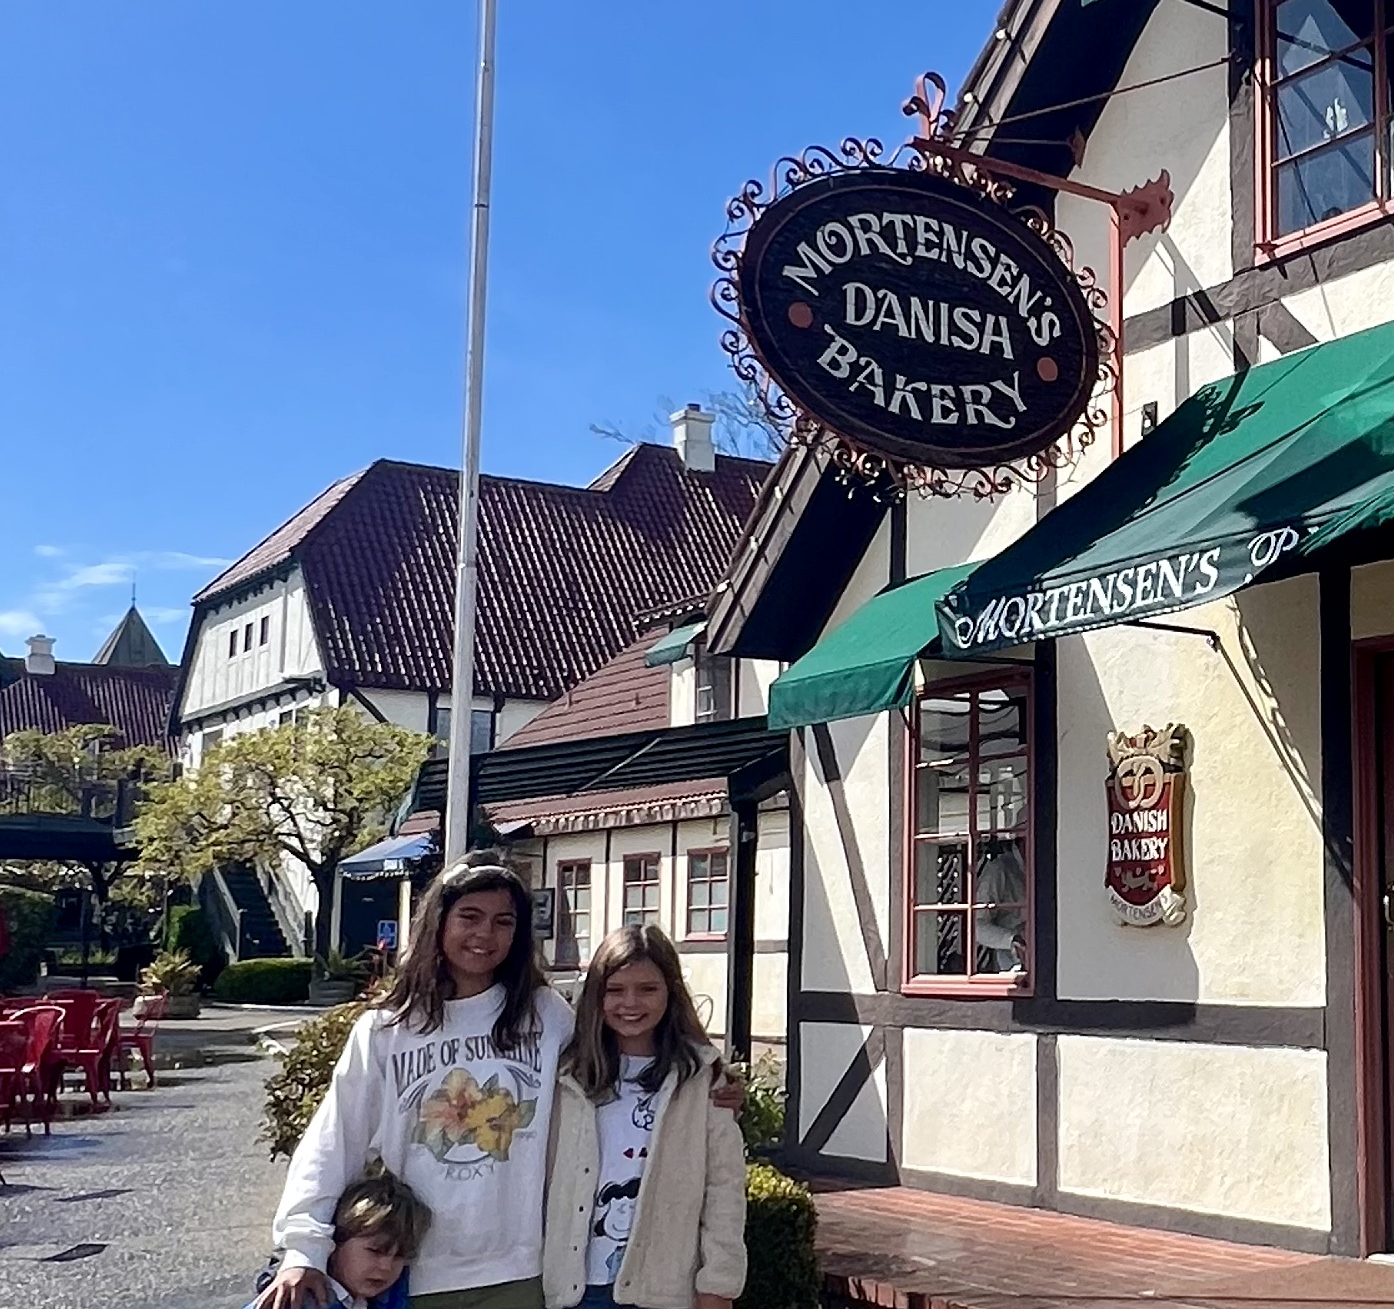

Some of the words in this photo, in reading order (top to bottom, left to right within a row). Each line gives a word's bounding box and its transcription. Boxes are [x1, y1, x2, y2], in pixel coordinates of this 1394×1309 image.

[782, 212, 1061, 347] MORTENSEN'S
[842, 282, 1014, 360] DANISH
[817, 324, 1027, 429] BAKERY
[955, 547, 1221, 649] MORTENSEN'S
[1111, 810, 1168, 834] DANISH
[1111, 837, 1168, 861] BAKERY
[440, 1038, 460, 1066] OF
